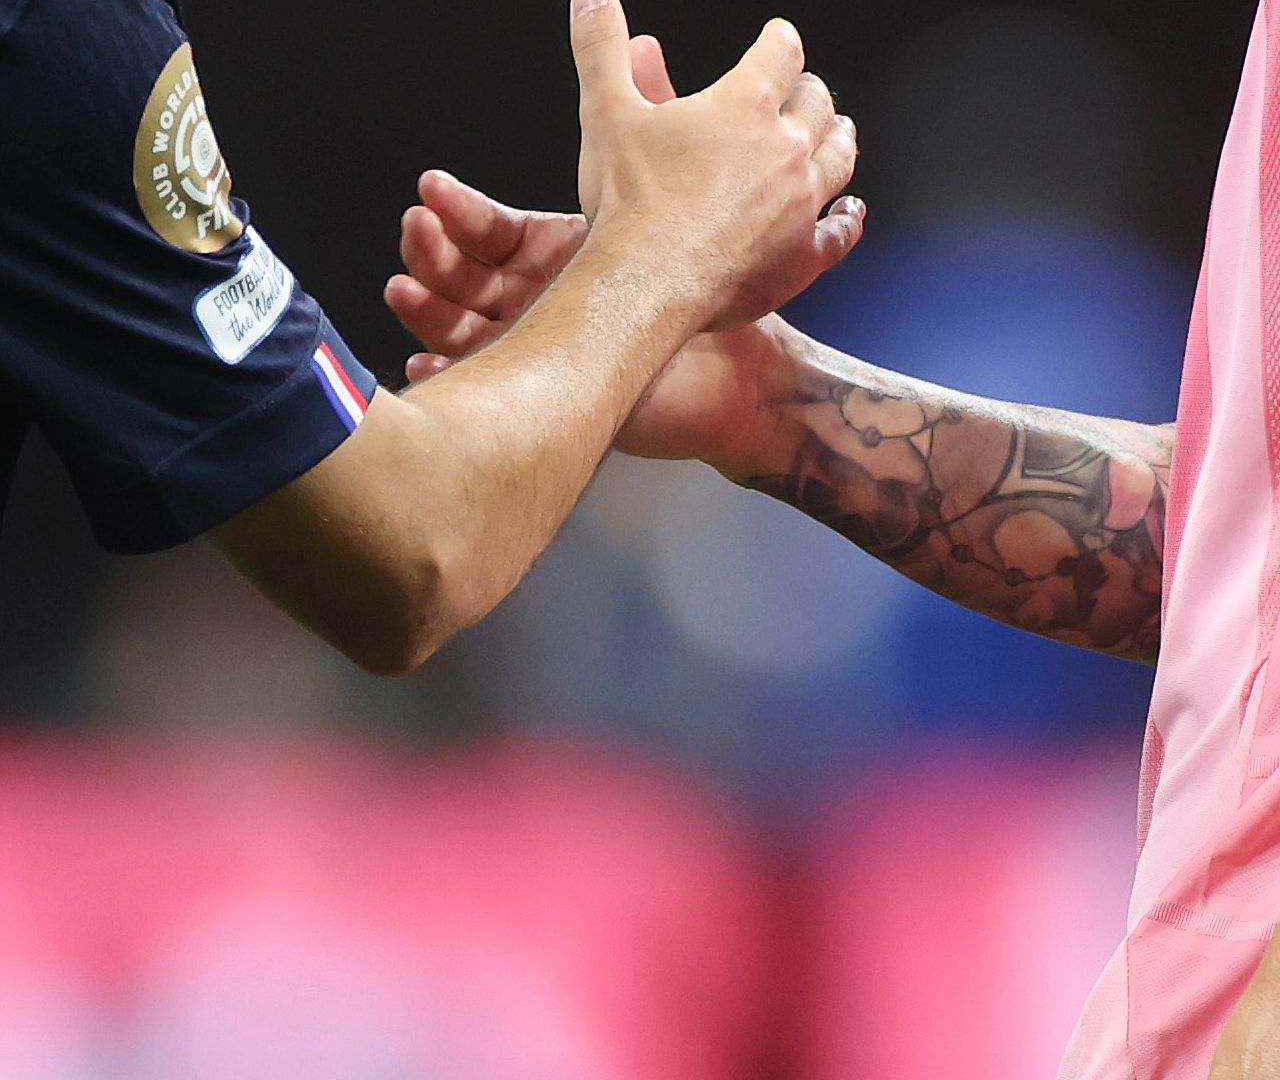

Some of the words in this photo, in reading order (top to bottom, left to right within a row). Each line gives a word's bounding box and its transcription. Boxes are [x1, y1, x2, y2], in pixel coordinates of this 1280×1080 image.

[152, 71, 193, 154] WORLD
[152, 161, 187, 220] CLUB
[228, 313, 254, 342] the
